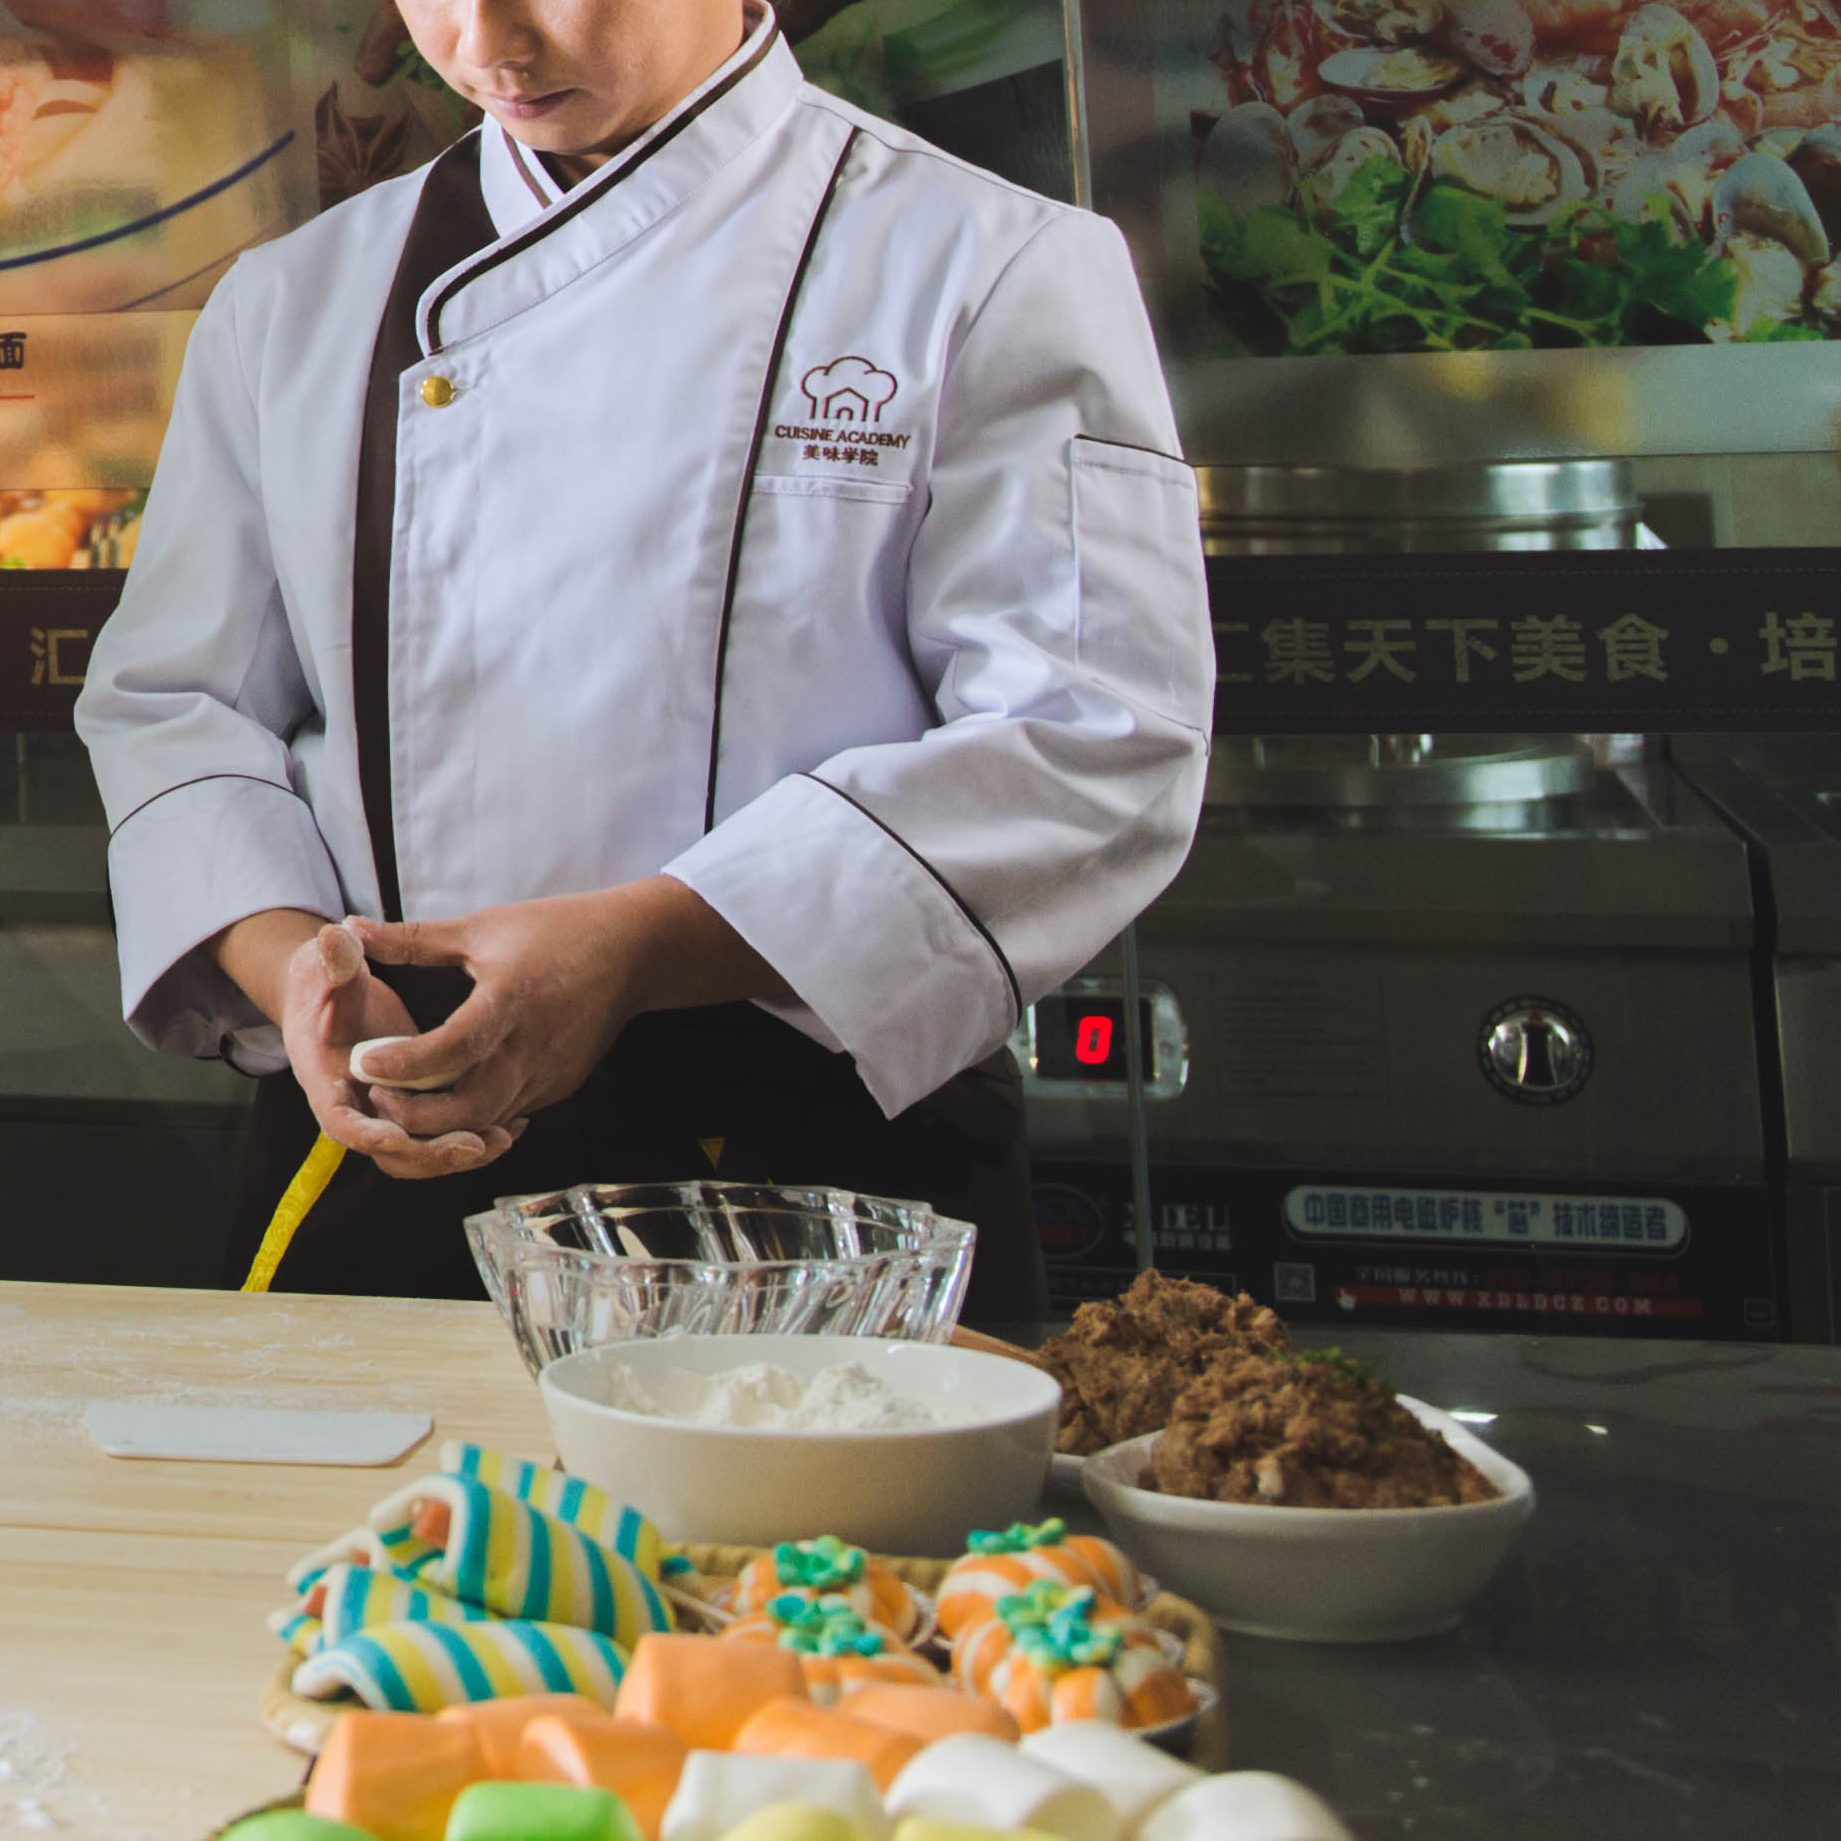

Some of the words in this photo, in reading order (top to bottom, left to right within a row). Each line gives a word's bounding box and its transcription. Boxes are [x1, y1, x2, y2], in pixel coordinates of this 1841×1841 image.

[774, 424, 835, 442] CUISINE
[835, 429, 911, 450] ACADEMY
[802, 444, 879, 466] 美味学院
[1075, 1016, 1113, 1065] 0
